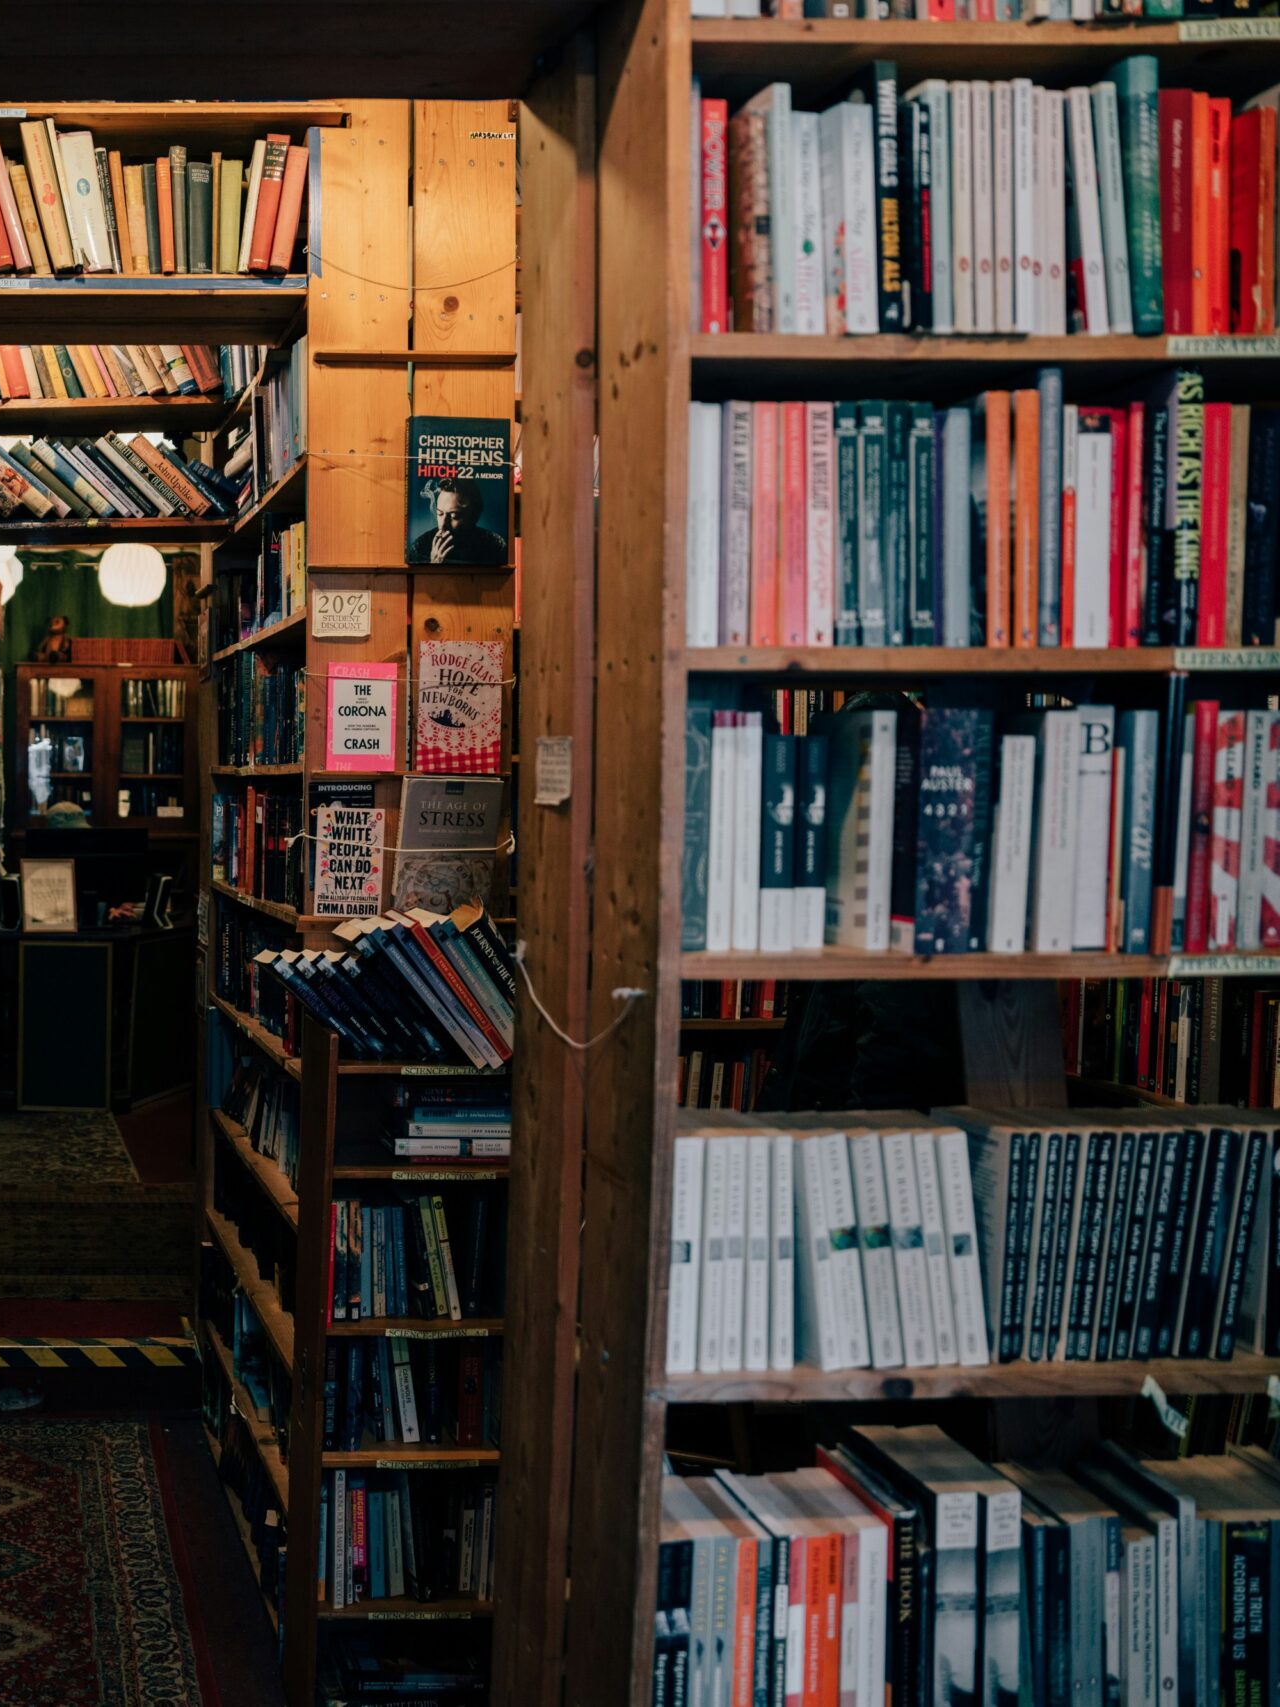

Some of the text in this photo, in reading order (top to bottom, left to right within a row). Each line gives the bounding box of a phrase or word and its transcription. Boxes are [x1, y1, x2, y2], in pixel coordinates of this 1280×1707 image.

[876, 79, 899, 187] WHITE GIRLS
[704, 120, 724, 210] POWER
[880, 198, 902, 292] HILTON ALS
[1173, 338, 1280, 353] LITERATUR
[1178, 371, 1204, 400] AS
[418, 434, 505, 450] CHRISTOPHER
[812, 410, 828, 446] MAYA
[1177, 402, 1203, 452] RICH
[418, 448, 504, 467] HITCHENS
[1153, 434, 1164, 460] Land
[155, 461, 194, 502] John Updike
[1177, 455, 1203, 485] AS
[150, 475, 181, 507] OLIGARCHY
[1176, 489, 1202, 526] THE
[318, 593, 368, 616] 20%
[322, 614, 361, 622] STUDENT
[431, 653, 470, 669] RODGE
[354, 685, 371, 695] THE
[440, 668, 484, 696] HOPE
[448, 686, 464, 696] FOR
[338, 706, 387, 716] CORONA
[421, 691, 480, 721] NEWBORNS
[344, 738, 380, 749] CRASH
[1081, 722, 1111, 755] B
[921, 778, 972, 791] AUSTER
[929, 765, 963, 777] PAUL
[318, 784, 372, 792] INTRODUCING
[334, 811, 371, 825] WHAT
[419, 811, 485, 827] STRESS
[421, 800, 489, 811] THE AGE OF
[331, 827, 372, 841] WHITE
[329, 843, 372, 857] PEOPLE
[329, 860, 371, 874] CAN DO
[334, 876, 365, 890] NEXT
[317, 903, 378, 915] EMMA DABIRI
[471, 927, 495, 959] JOURNEY
[495, 964, 510, 982] THE
[395, 1171, 474, 1180] SCIENCE-FICTION
[1134, 1141, 1152, 1216] THE BRIDGE
[1157, 1135, 1178, 1213] THE BRIDGE
[1210, 1134, 1228, 1201] IAIN BANKS
[1007, 1137, 1021, 1253] THE WASP FACTORY
[1040, 1138, 1058, 1254] THE WASP FACTORY
[1089, 1138, 1111, 1255] THE WASP FACTORY
[1235, 1138, 1260, 1253] WALKING ON GLASS
[1200, 1205, 1218, 1274] THE BRIDGE
[1123, 1223, 1141, 1302] IAIN BANKS
[1144, 1220, 1166, 1300] IAIN BANKS
[1003, 1258, 1014, 1325] IAIN BANKS
[1033, 1258, 1048, 1326] IAIN BANKS
[1081, 1257, 1097, 1325] IAIN BANKS
[1224, 1256, 1242, 1324] IAIN BANKS
[389, 1328, 465, 1338] SCIENCE-FICTION
[380, 1459, 459, 1469] SCIENCE-FICTION
[356, 1490, 364, 1518] AUGUST
[899, 1525, 913, 1623] THE HOOK
[1233, 1554, 1246, 1660] ACCORDING TO US
[1249, 1577, 1262, 1633] THE TRUTH
